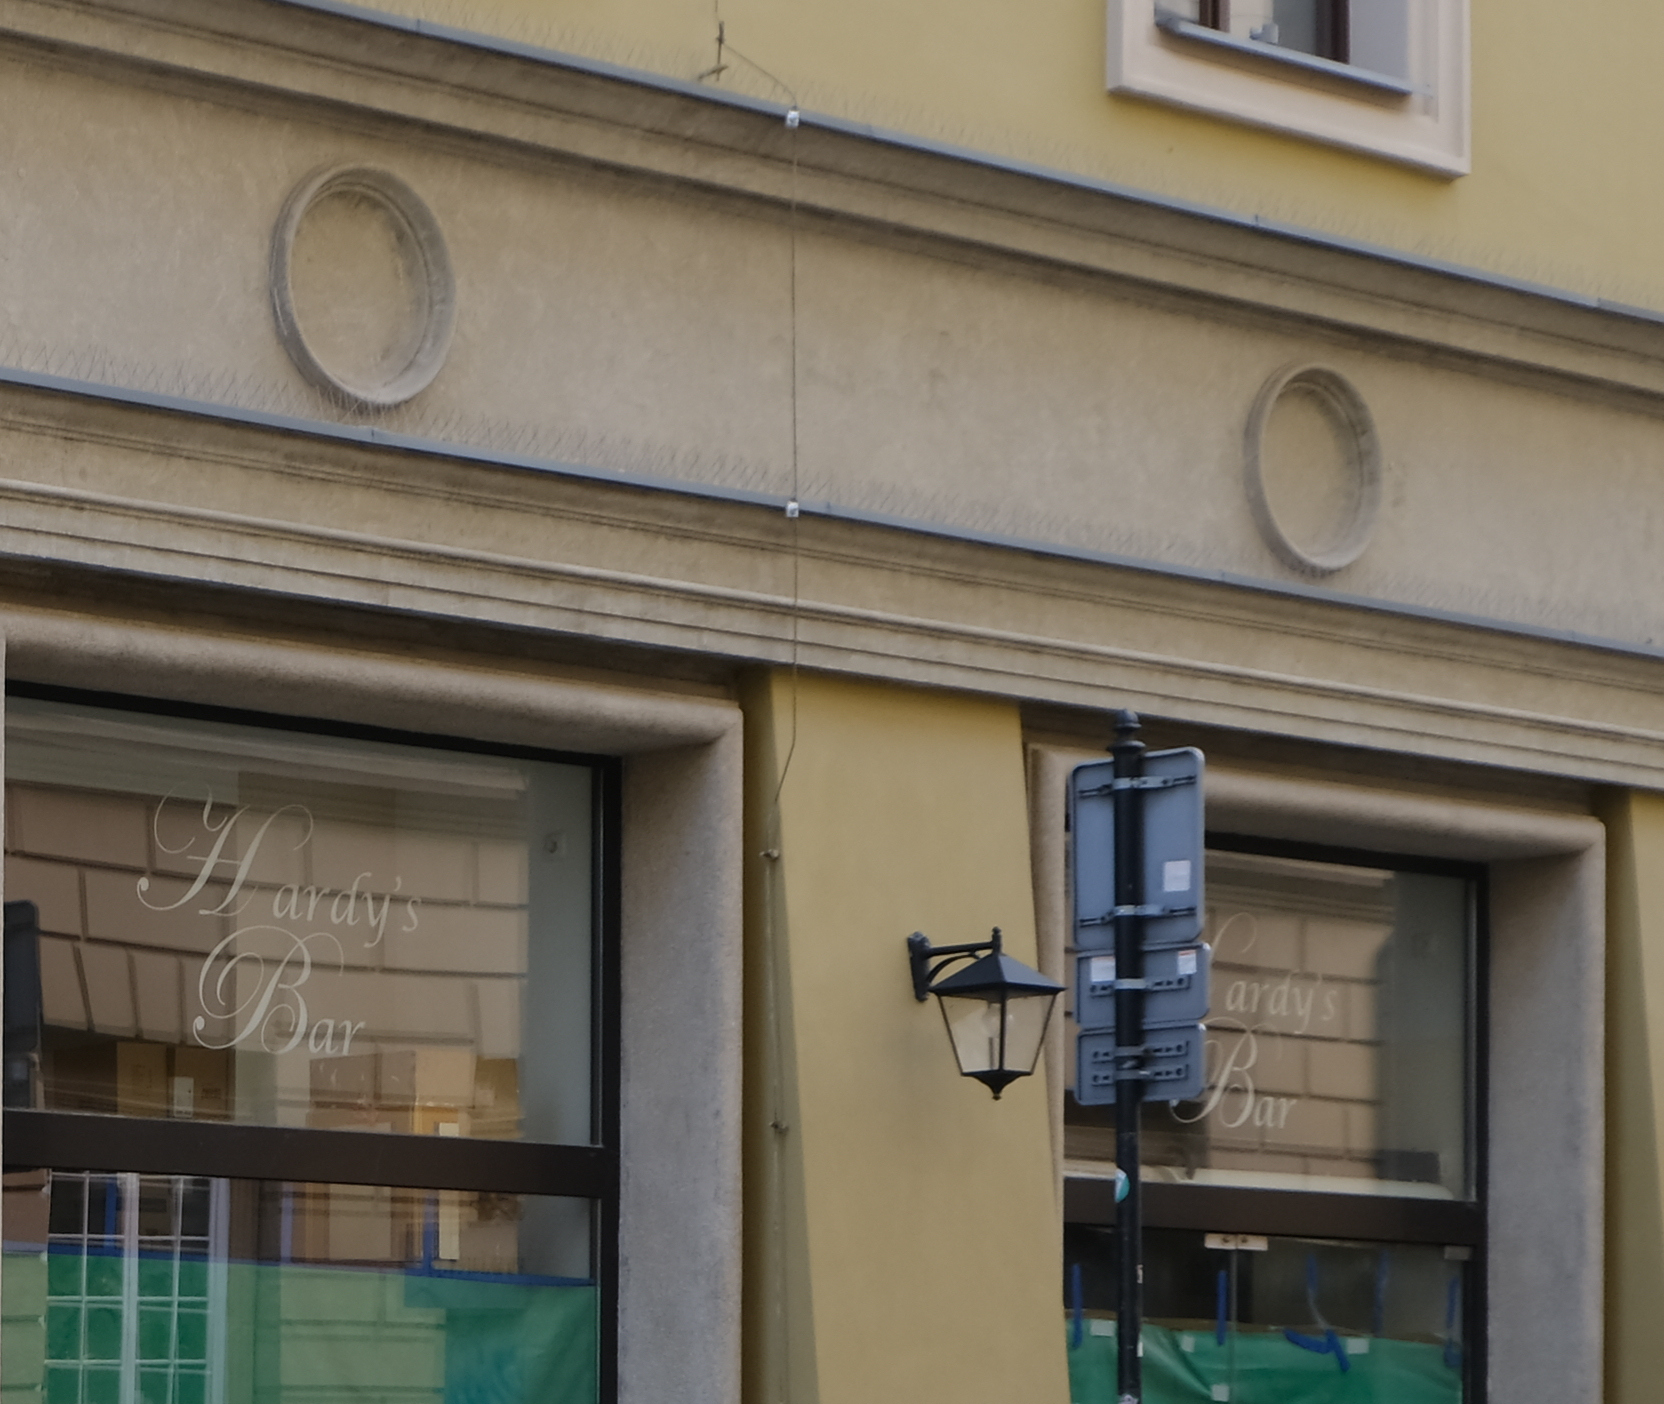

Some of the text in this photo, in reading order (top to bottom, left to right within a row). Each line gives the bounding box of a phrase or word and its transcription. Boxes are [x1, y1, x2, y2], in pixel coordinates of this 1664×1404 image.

[136, 782, 423, 948] Hardy's
[192, 924, 365, 1056] Bar
[1170, 1015, 1298, 1130] Bar
